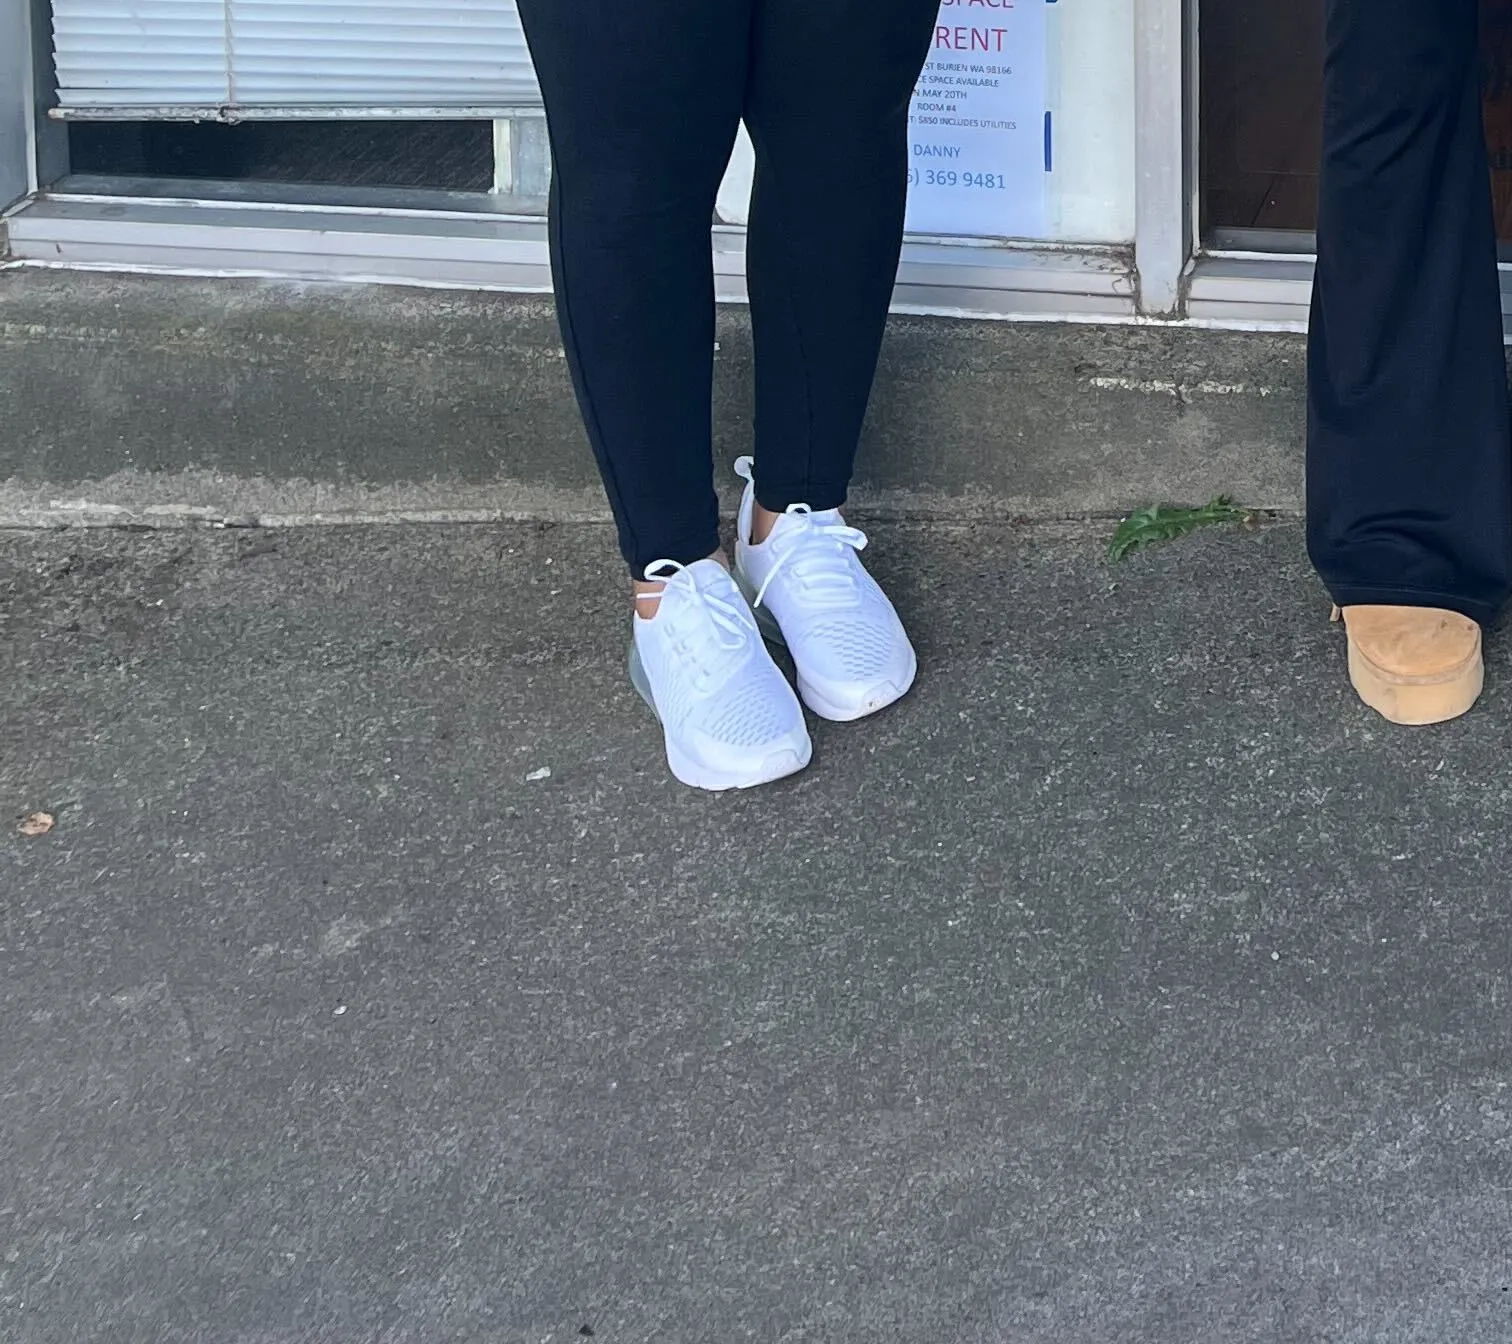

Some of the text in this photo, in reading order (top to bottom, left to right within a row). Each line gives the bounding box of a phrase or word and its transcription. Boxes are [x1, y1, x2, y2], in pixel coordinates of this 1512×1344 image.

[936, 26, 1008, 52] RENT
[937, 63, 967, 72] BURIEN
[970, 65, 984, 73] WA
[929, 75, 954, 85] SPACE
[956, 77, 1000, 88] AVAILABLE
[922, 89, 942, 98] MAY
[945, 90, 967, 99] 20TH
[917, 102, 944, 112] ROOM
[940, 117, 979, 128] INCLUDES
[913, 143, 961, 158] DANNY
[925, 169, 958, 187] 369
[962, 171, 1006, 190] 9481
